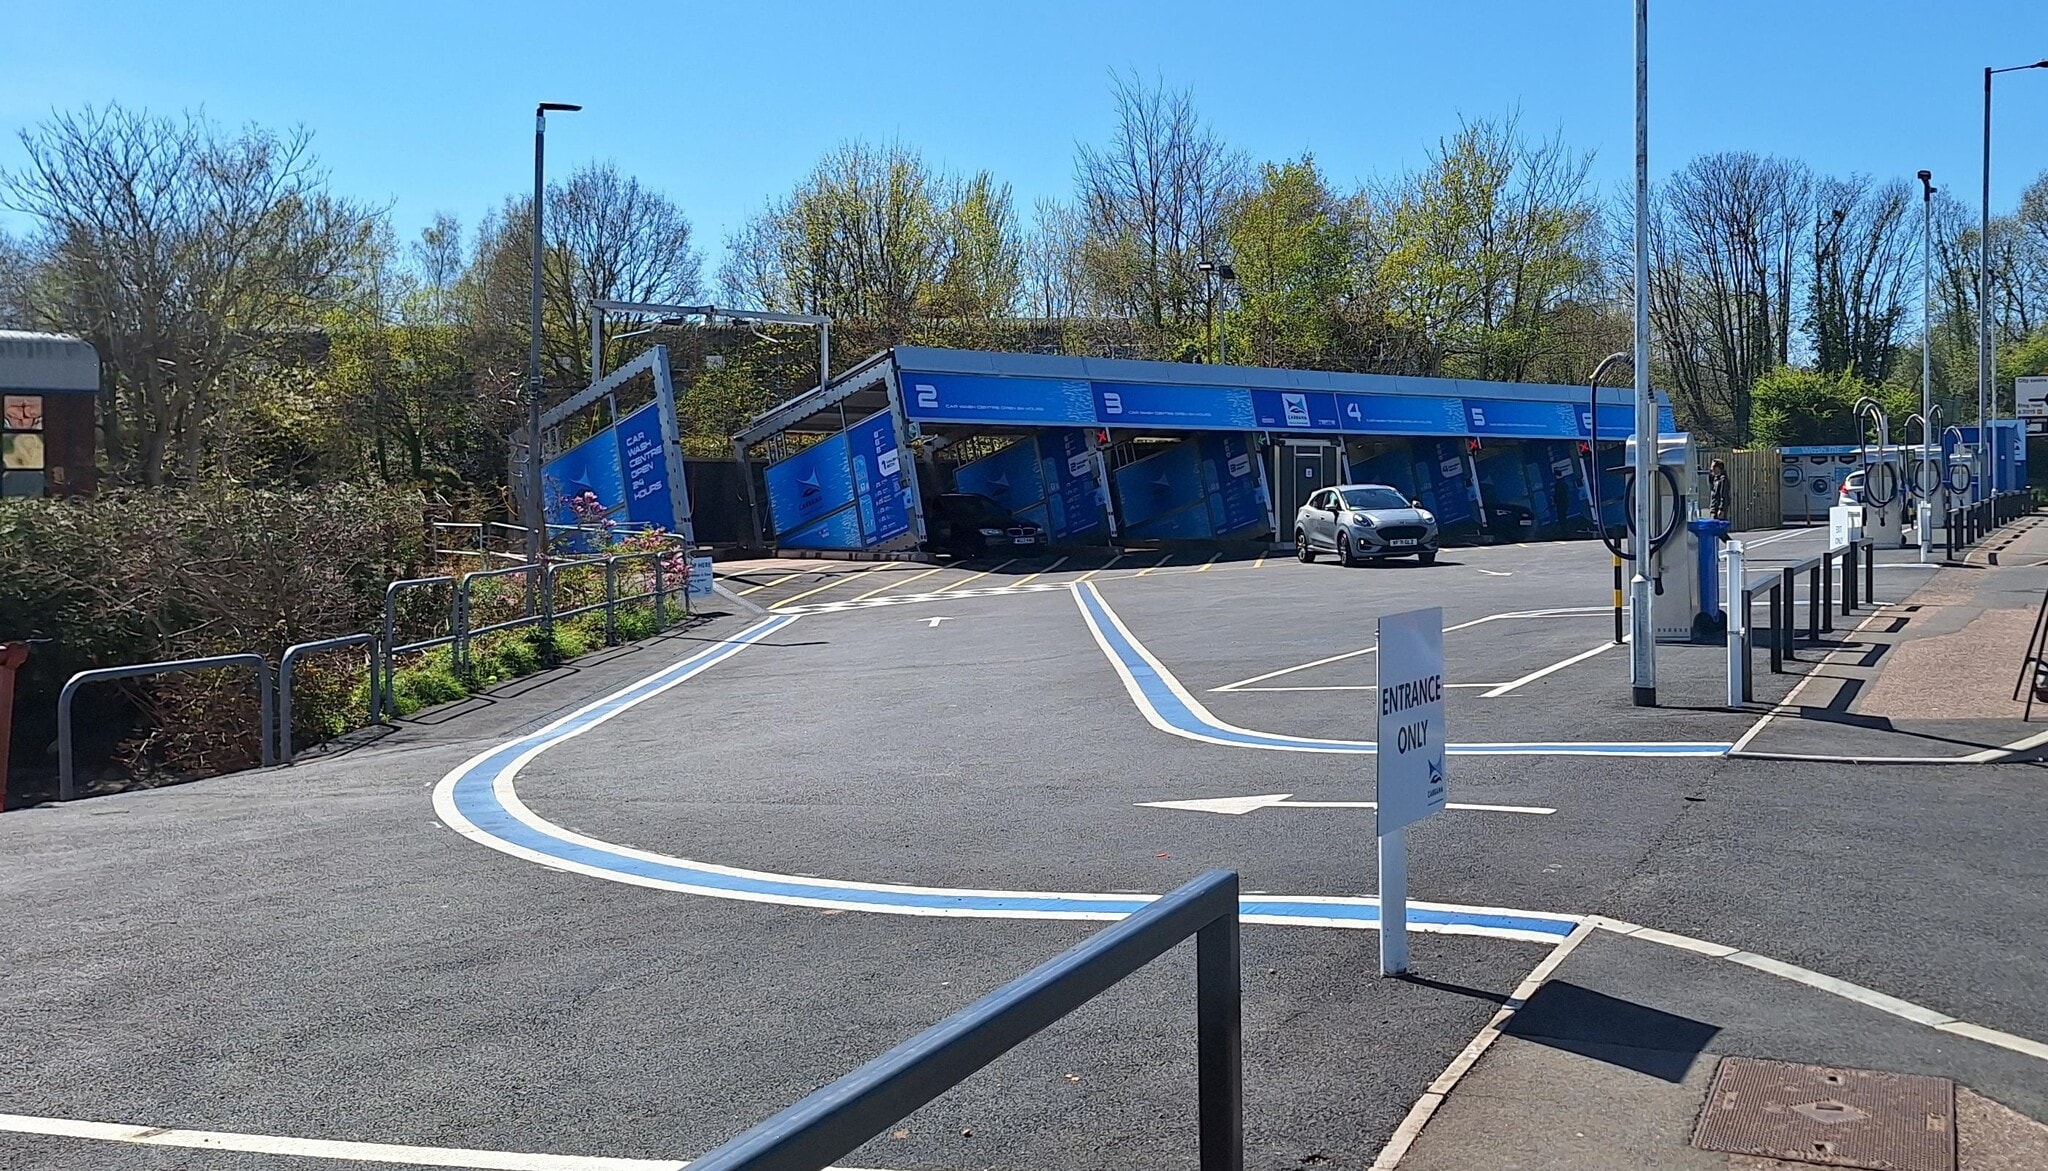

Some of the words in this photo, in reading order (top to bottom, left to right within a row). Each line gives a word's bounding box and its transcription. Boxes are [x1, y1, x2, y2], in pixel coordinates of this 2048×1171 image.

[915, 384, 938, 408] 2
[1103, 392, 1123, 414] 3
[1347, 402, 1362, 422] 4
[1471, 407, 1486, 426] 5
[626, 432, 645, 447] CAR
[627, 439, 652, 457] WASH
[629, 444, 663, 468] CENTRE
[631, 461, 654, 479] OPEN
[632, 478, 644, 490] 24
[634, 480, 662, 501] HOURS
[1383, 675, 1441, 716] ENTRANCE
[1398, 720, 1428, 755] ONLY
